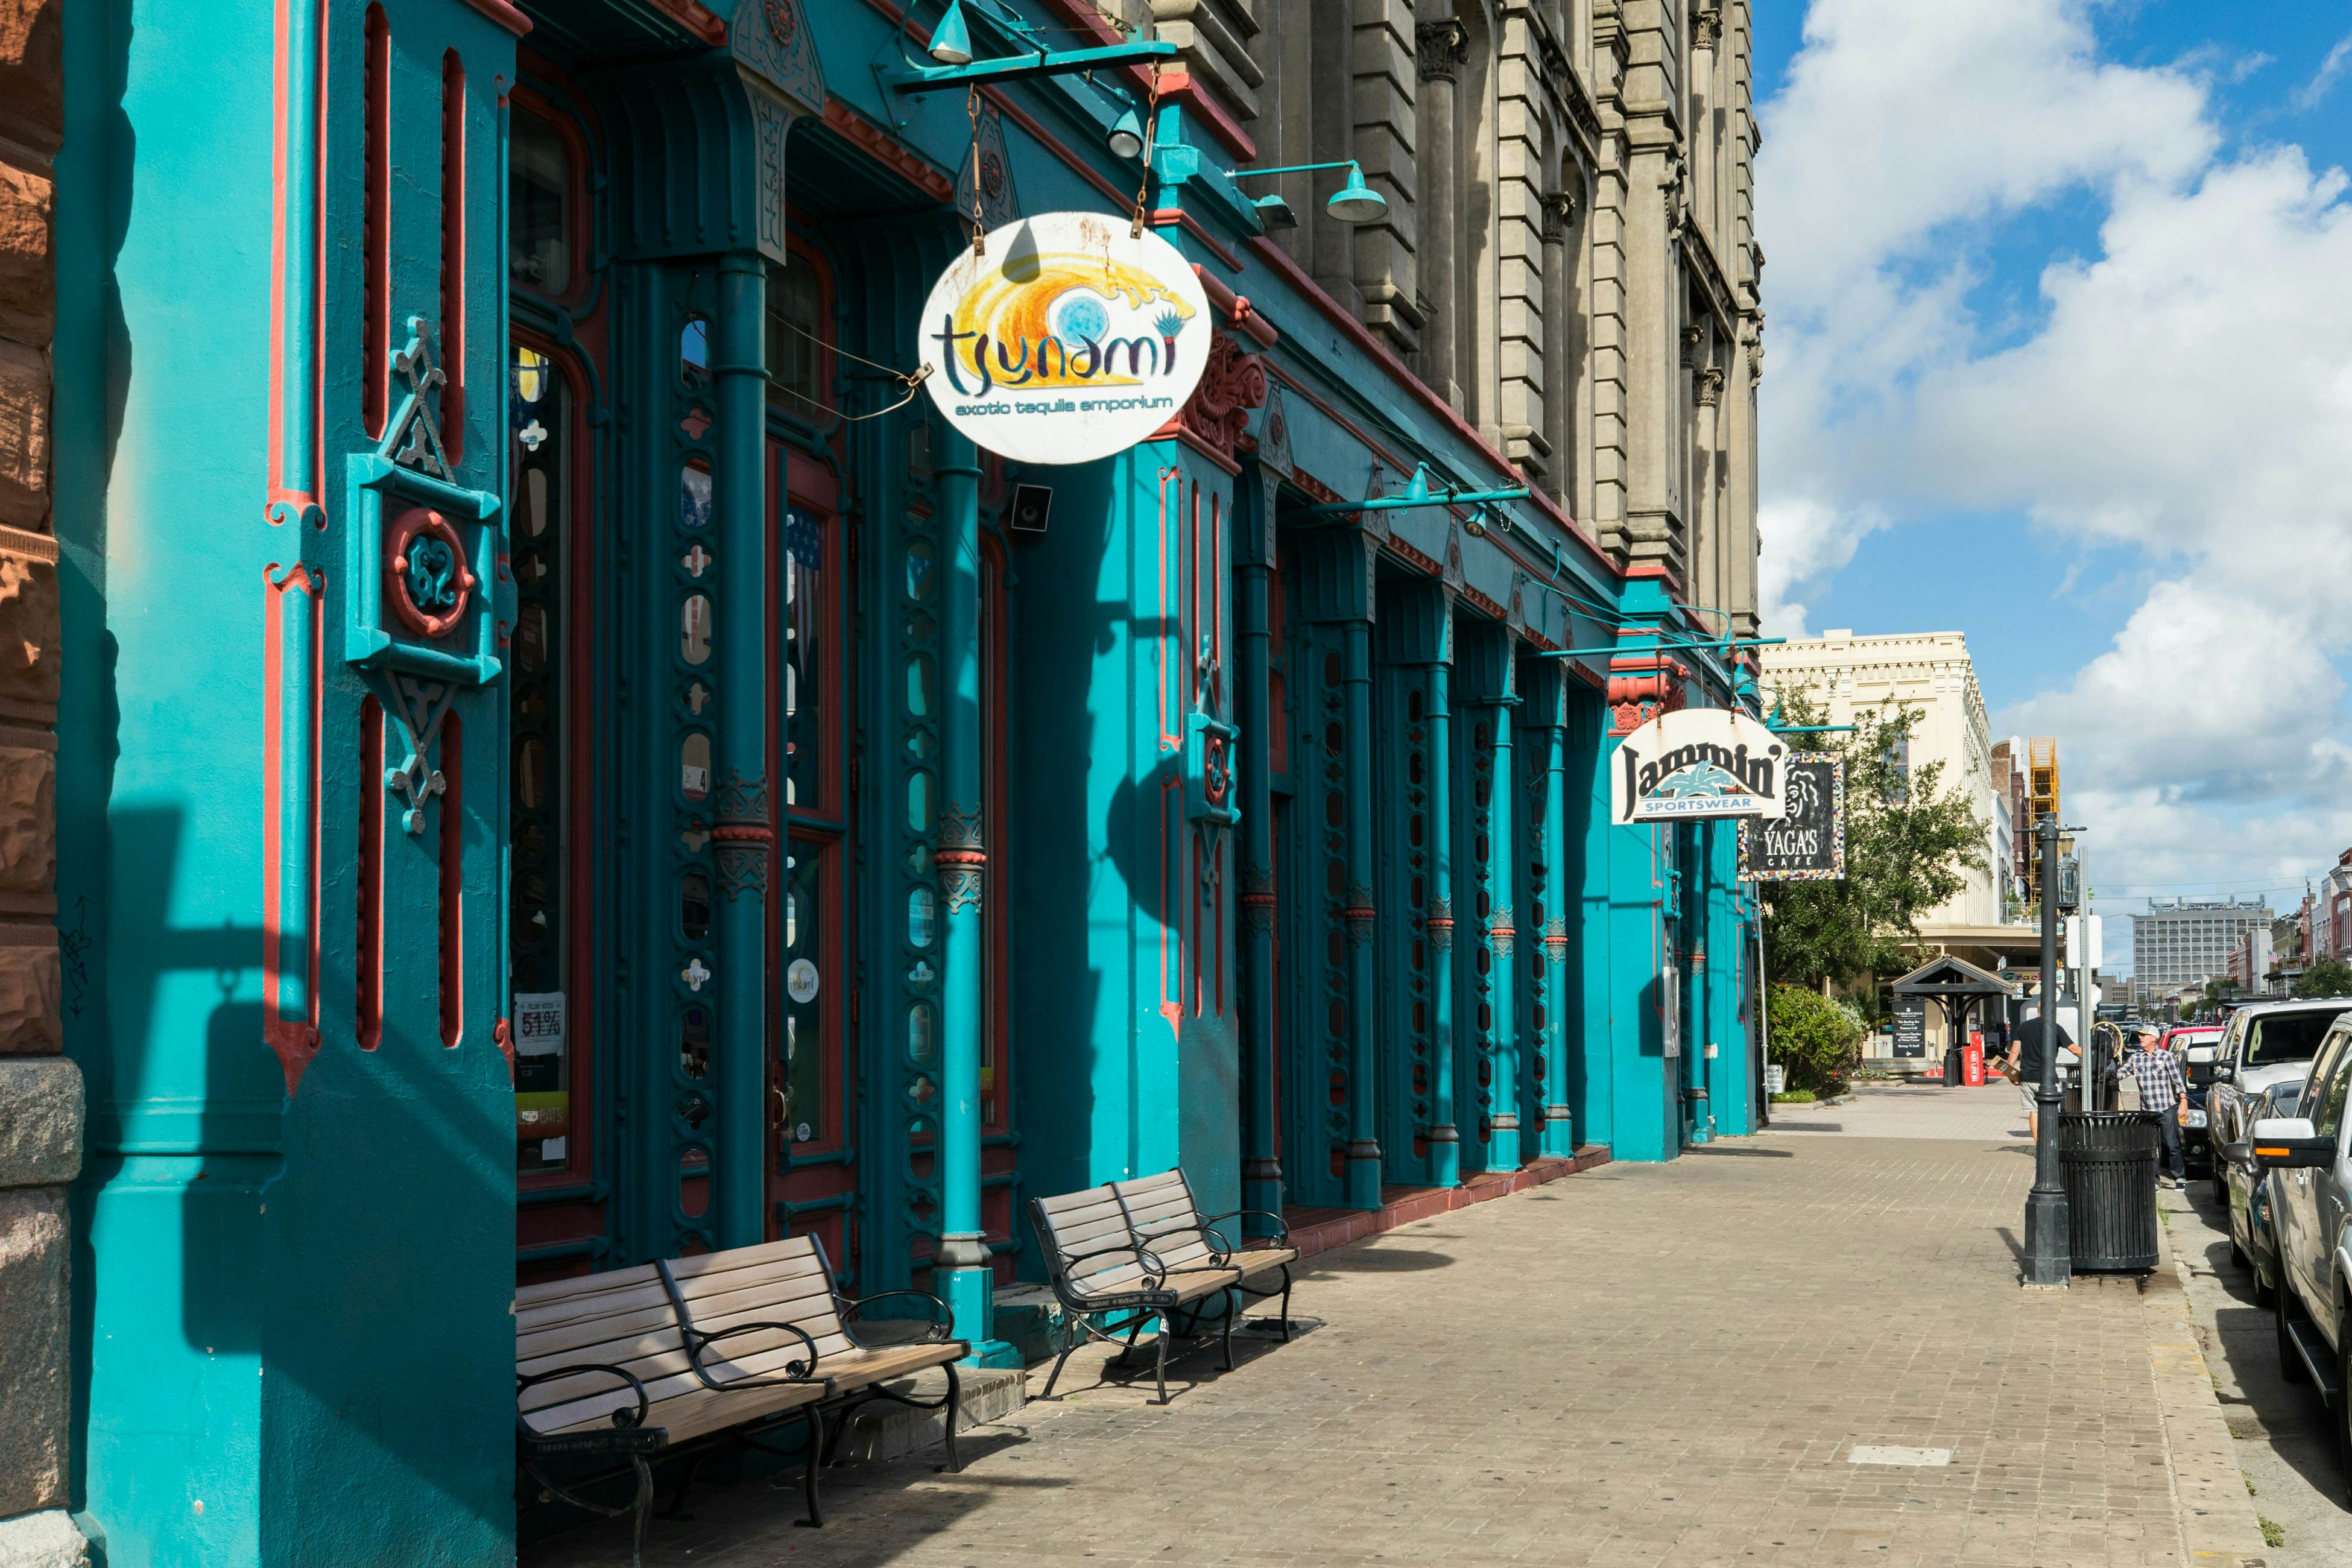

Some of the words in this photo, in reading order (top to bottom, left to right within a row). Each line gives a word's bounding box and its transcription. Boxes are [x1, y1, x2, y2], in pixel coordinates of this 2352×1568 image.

[931, 308, 1184, 398] tsunami
[955, 402, 1011, 416] exotic
[1016, 398, 1075, 416] tequila
[1080, 395, 1173, 413] emporium
[1622, 742, 1782, 822] Jammin'
[1645, 798, 1751, 812] SPORTSWEAR
[1764, 829, 1818, 856] YAGA'S
[522, 1010, 560, 1037] 51%
